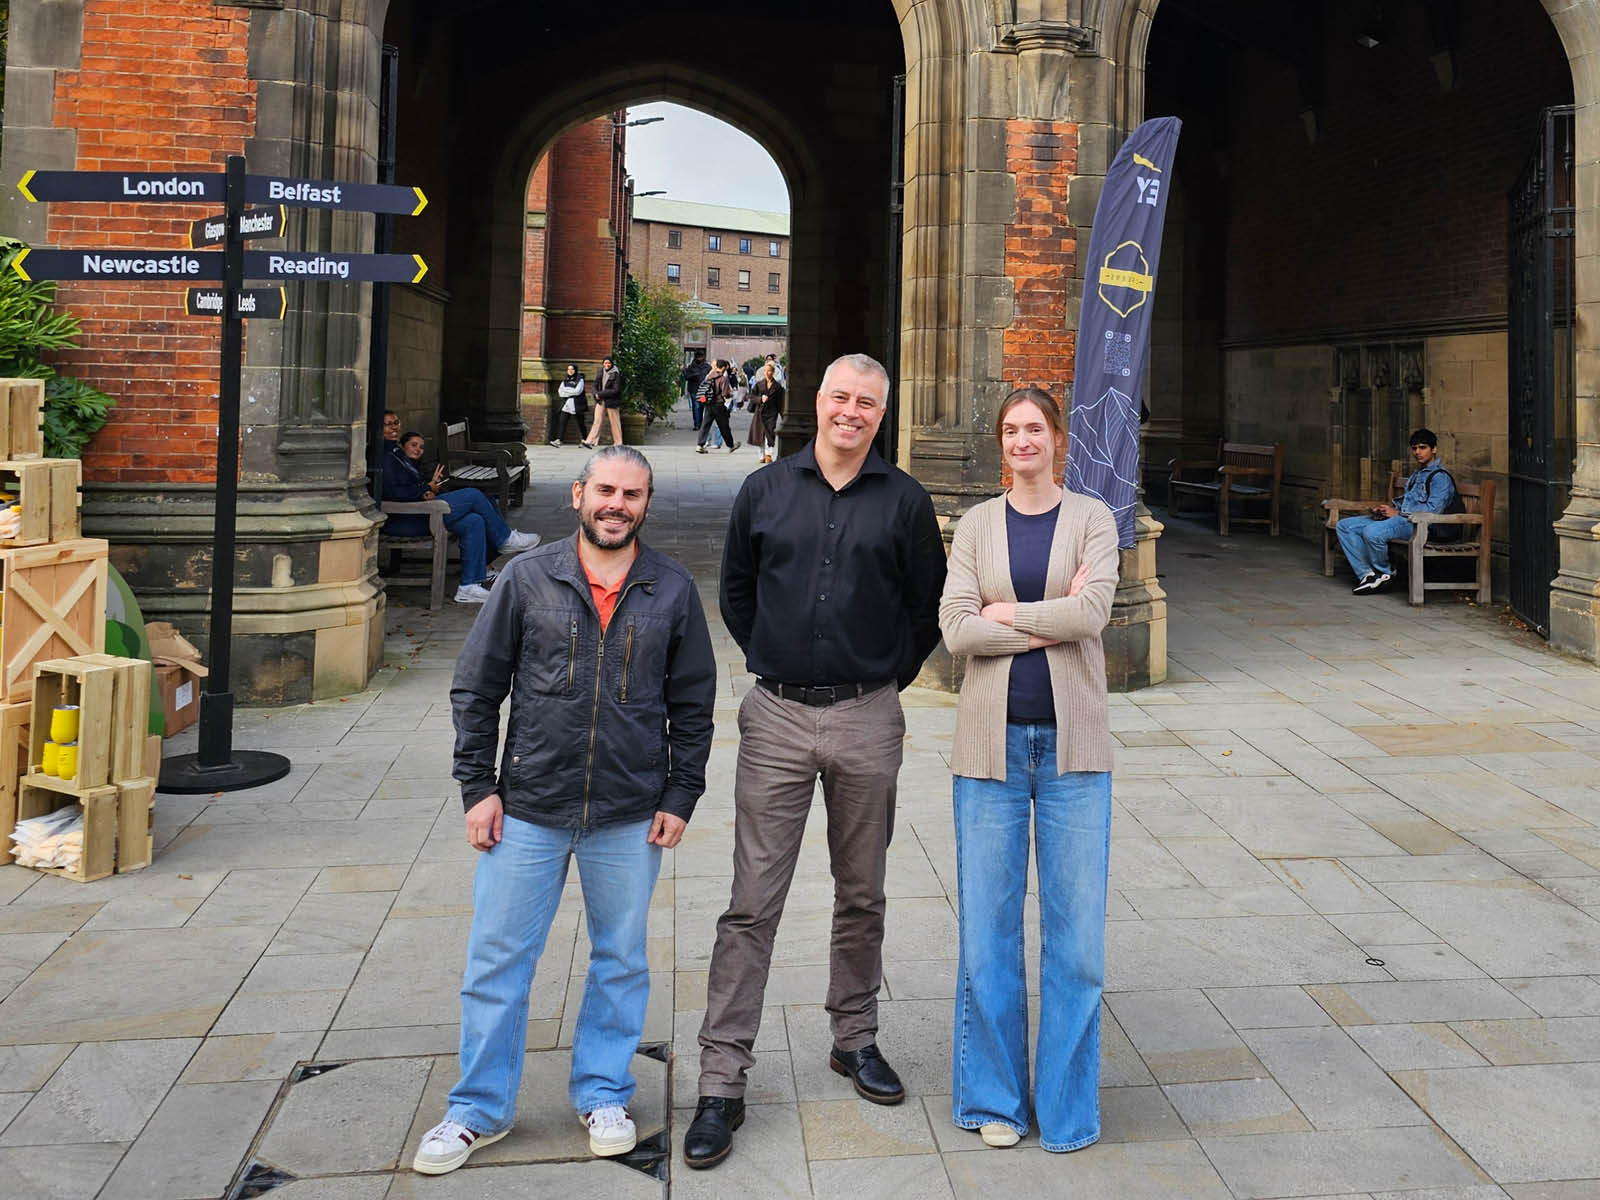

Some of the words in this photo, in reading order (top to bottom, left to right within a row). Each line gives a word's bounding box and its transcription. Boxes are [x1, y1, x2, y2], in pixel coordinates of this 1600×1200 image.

[123, 177, 205, 196] London
[269, 181, 342, 204] Belfast
[239, 213, 274, 233] Manchester
[83, 254, 201, 274] Newcastle
[269, 256, 350, 279] Reading
[196, 292, 223, 314] Cambridge
[238, 294, 256, 311] Leeds
